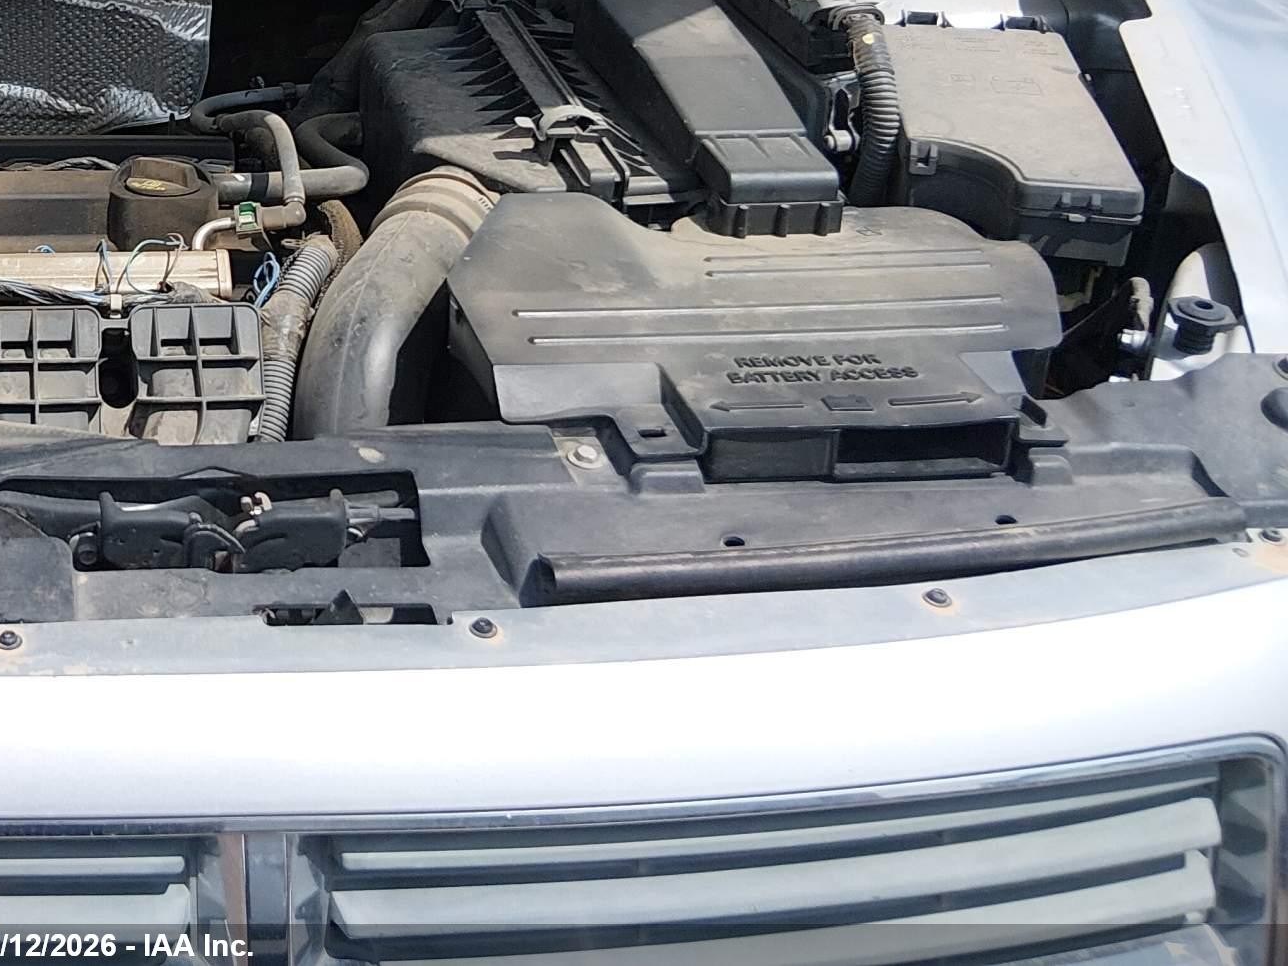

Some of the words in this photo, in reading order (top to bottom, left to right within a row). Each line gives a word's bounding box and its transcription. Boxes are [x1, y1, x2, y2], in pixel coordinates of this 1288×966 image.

[733, 355, 831, 368] REMOVE
[832, 353, 882, 365] FOR
[726, 369, 821, 384] BATTERY
[830, 366, 918, 381] ACCESS
